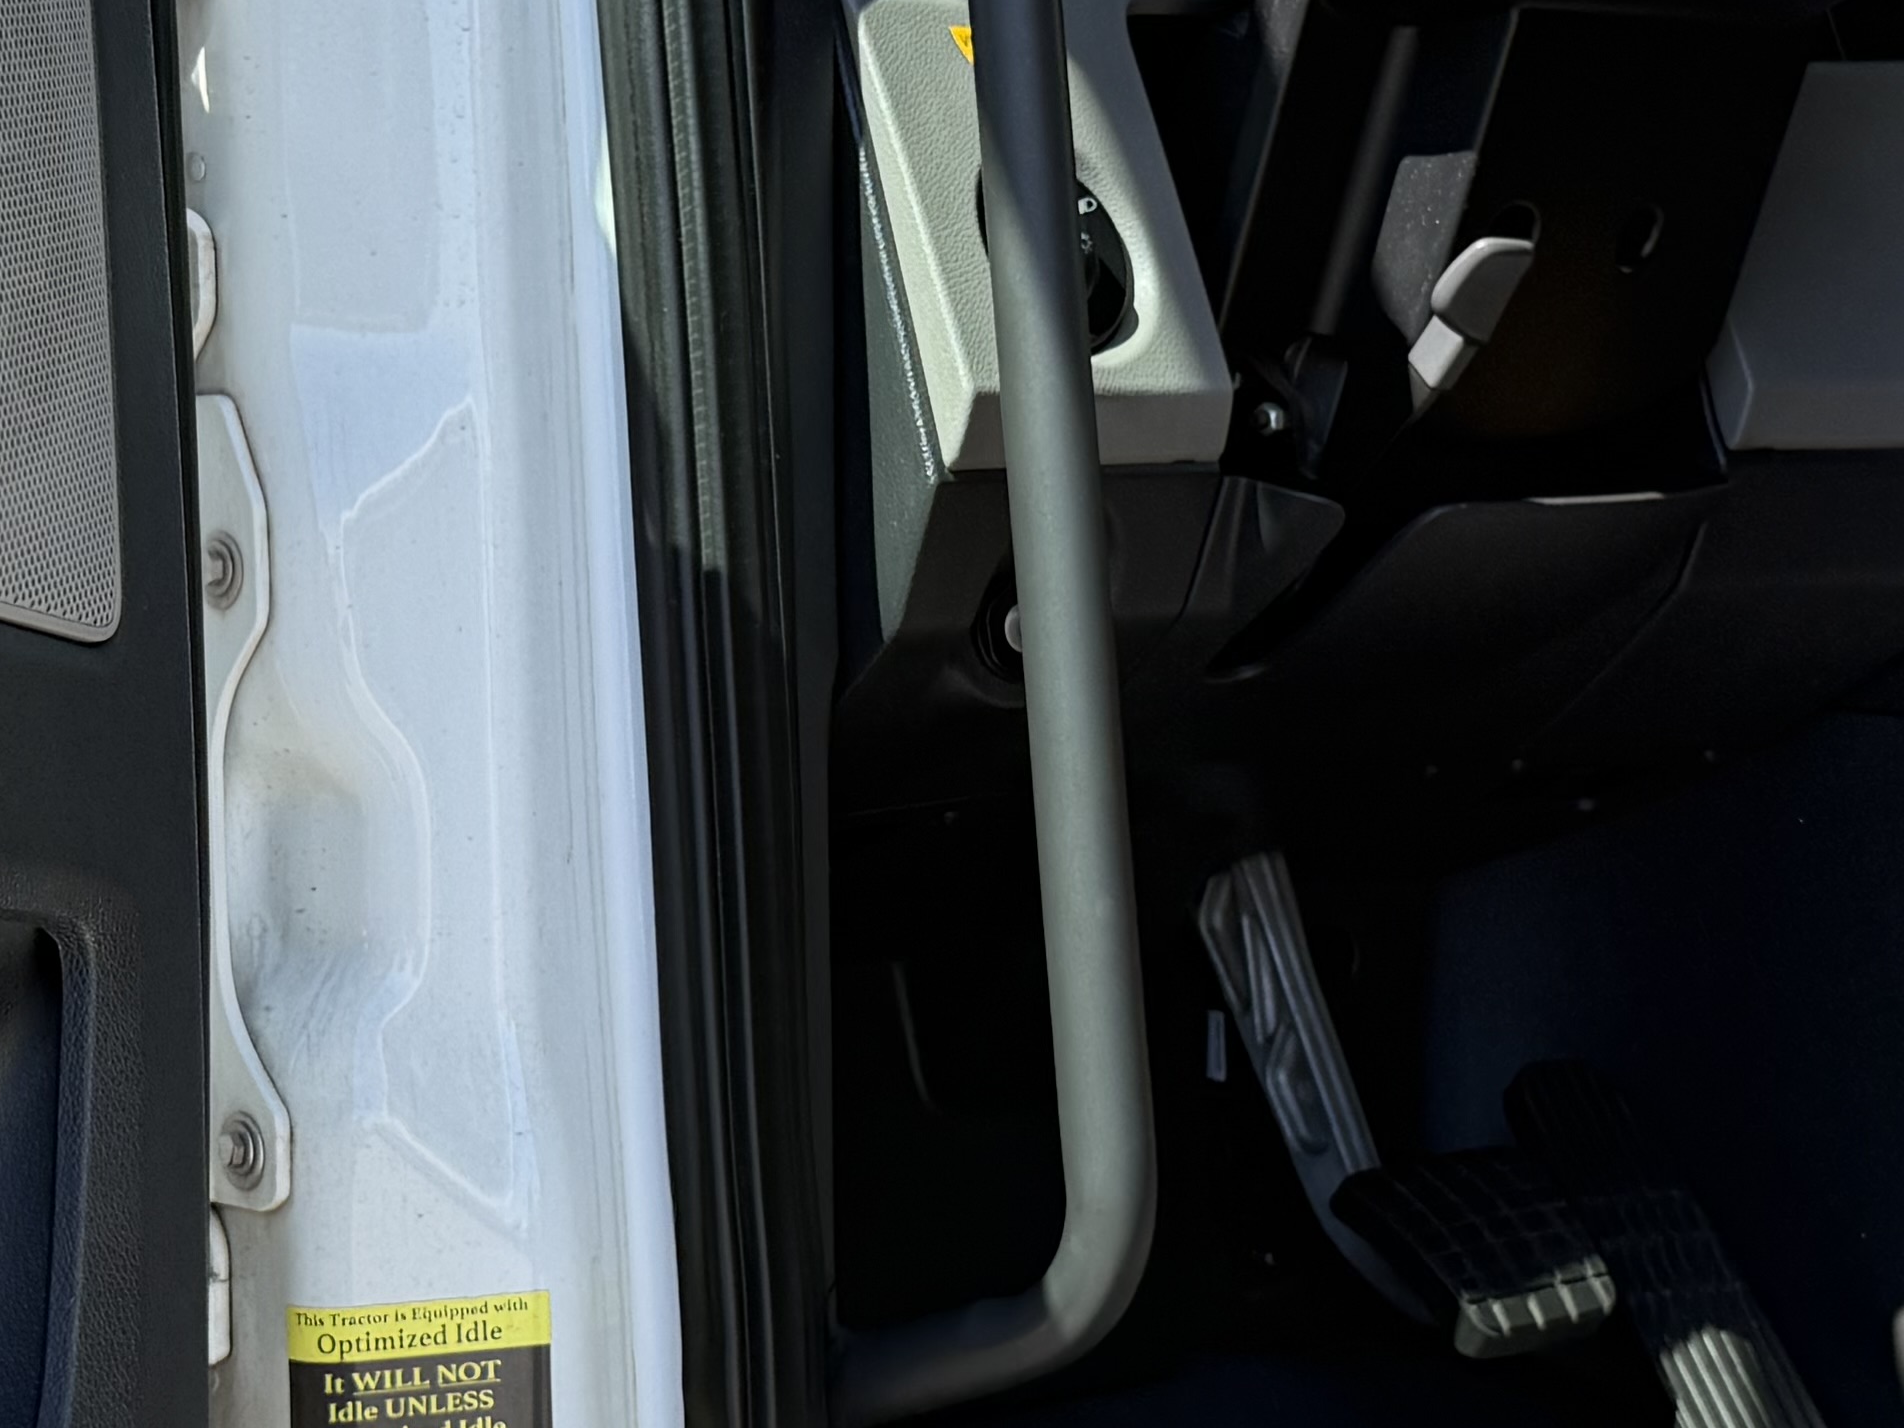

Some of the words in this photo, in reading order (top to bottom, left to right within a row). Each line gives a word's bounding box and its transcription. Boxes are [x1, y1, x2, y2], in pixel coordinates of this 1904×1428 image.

[296, 1312, 324, 1327] This
[330, 1313, 389, 1328] Tractor
[395, 1308, 406, 1322] is
[412, 1299, 489, 1324] Equipped
[494, 1297, 528, 1313] with
[317, 1324, 446, 1361] Optimized
[456, 1320, 502, 1344] Idle
[324, 1373, 345, 1394] It
[352, 1366, 430, 1393] WILL
[437, 1359, 501, 1384] NOT
[328, 1400, 378, 1424] Idle
[385, 1389, 494, 1419] UNLESS
